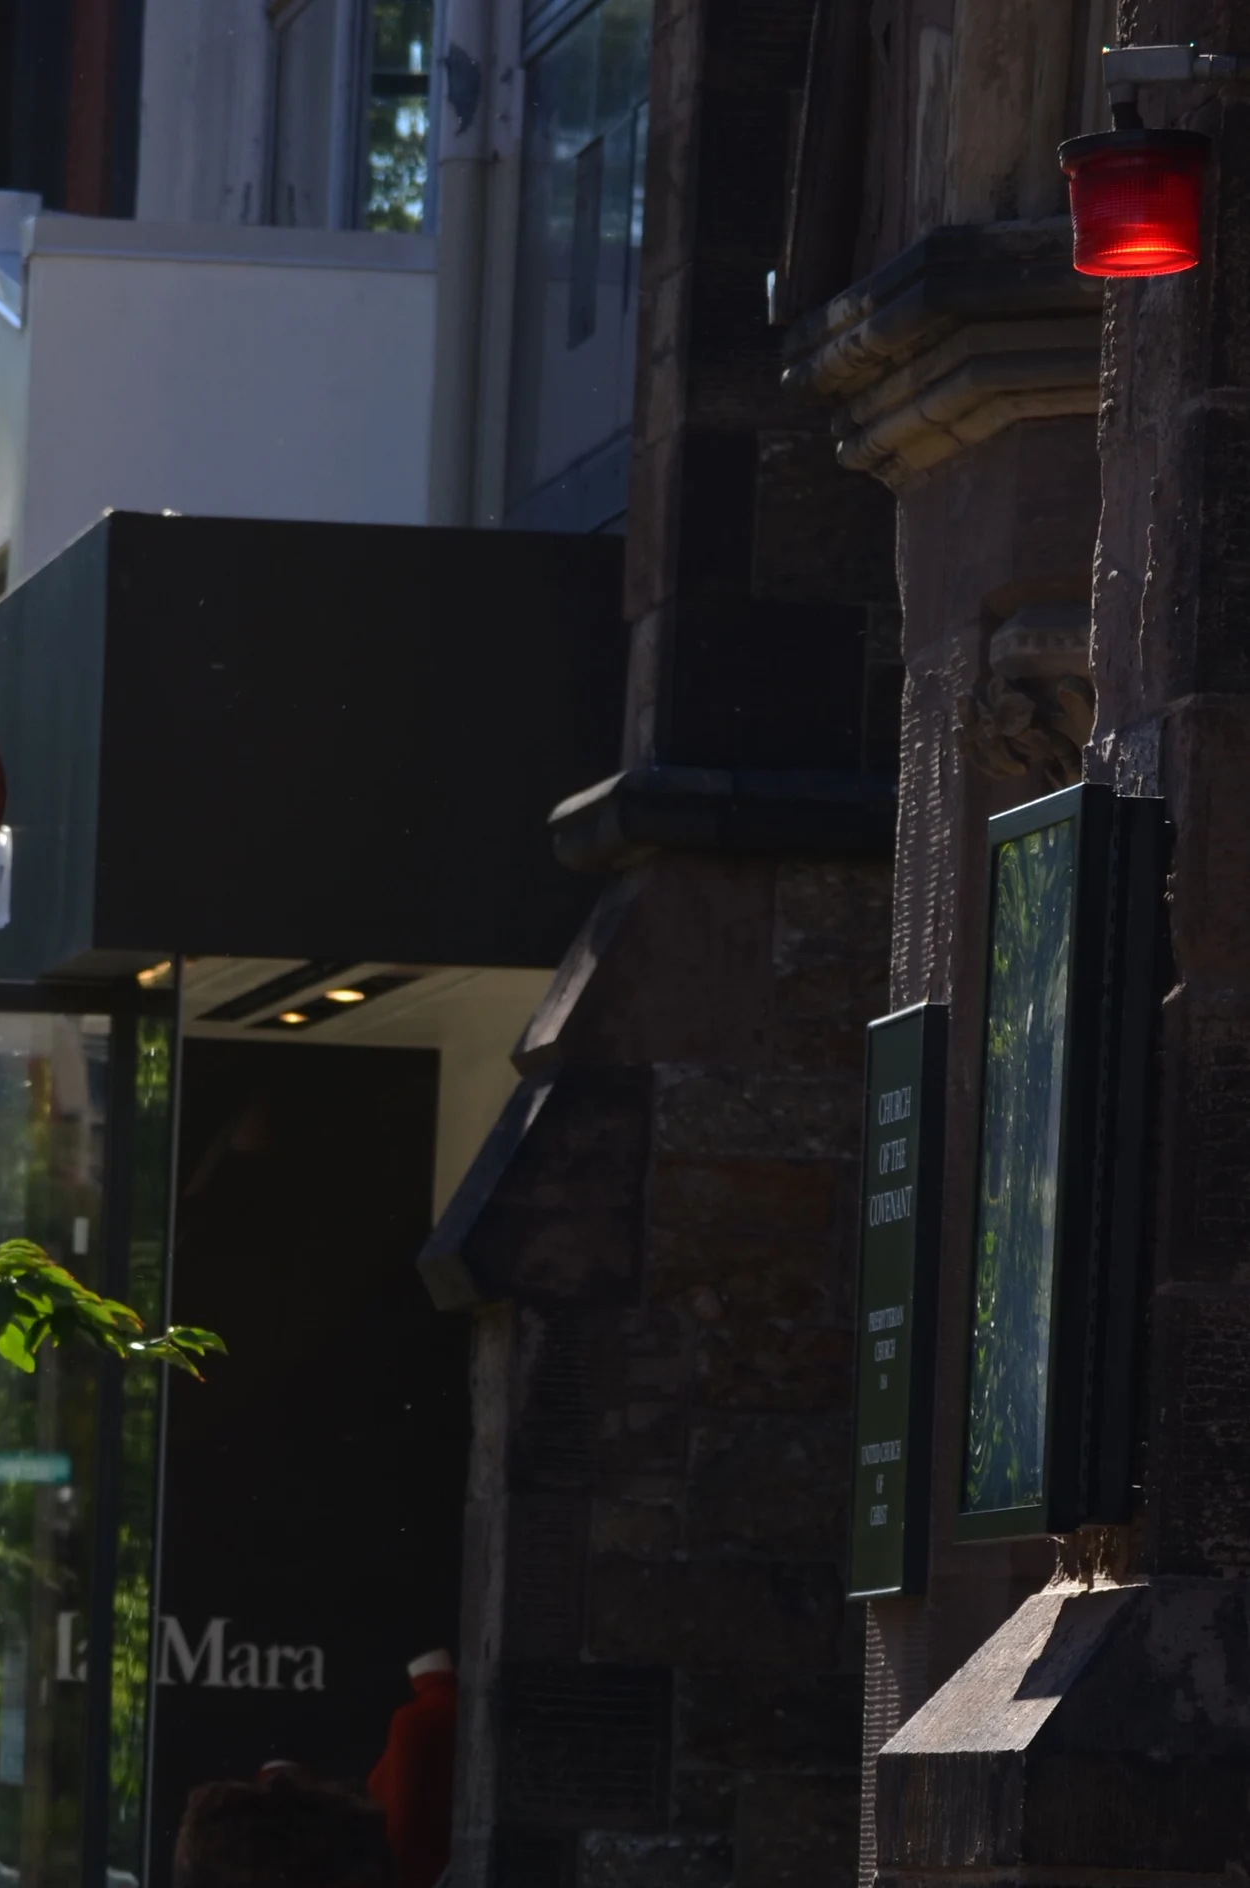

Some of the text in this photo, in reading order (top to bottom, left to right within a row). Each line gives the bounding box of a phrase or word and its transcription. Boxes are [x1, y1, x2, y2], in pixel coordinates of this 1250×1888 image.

[878, 1085, 912, 1126] CHURCH
[879, 1137, 907, 1175] OF THE
[869, 1186, 913, 1227] COVENANT
[875, 1338, 896, 1362] CHURCH
[861, 1439, 902, 1466] UNITED CHURCH
[876, 1473, 884, 1494] OF
[870, 1504, 889, 1527] CHRIST
[157, 1614, 327, 1691] Mara
